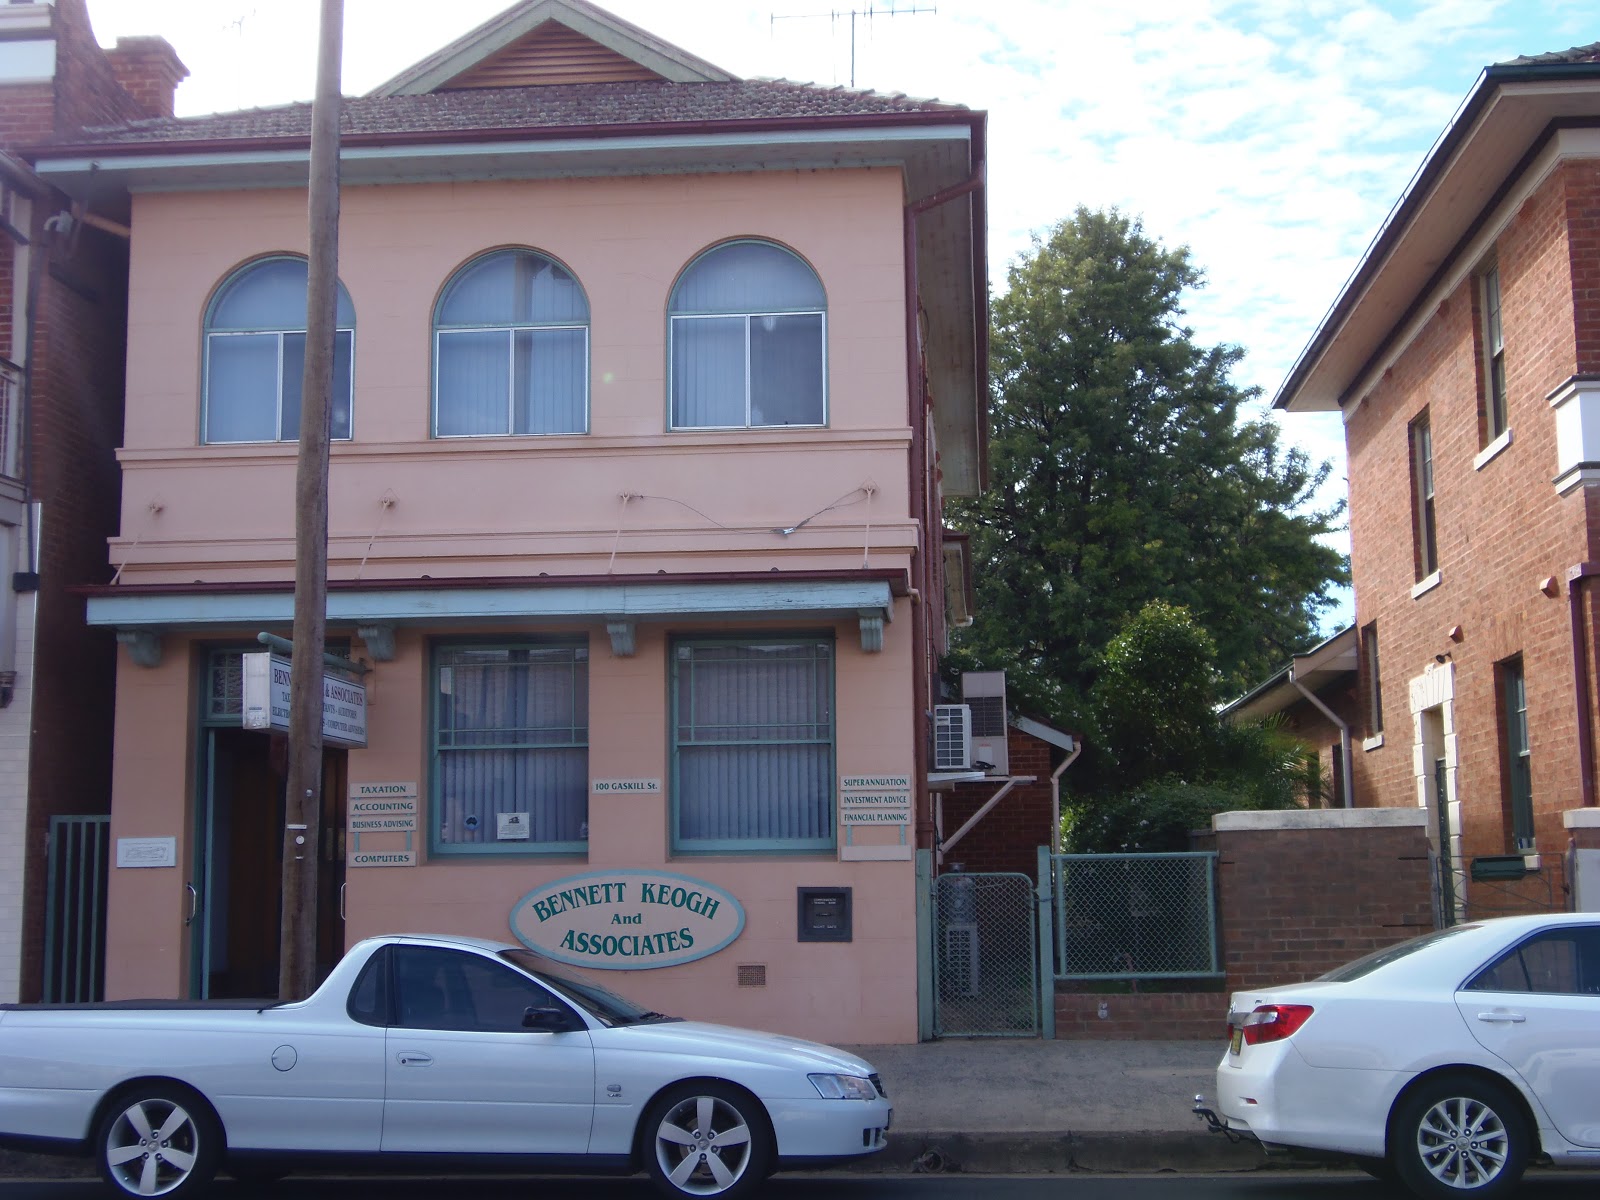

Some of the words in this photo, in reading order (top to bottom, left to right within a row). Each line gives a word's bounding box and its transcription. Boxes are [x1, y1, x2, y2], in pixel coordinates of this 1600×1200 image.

[330, 685, 364, 707] ASSOCIATES
[595, 782, 610, 791] 100
[611, 782, 645, 791] GASKILL
[647, 782, 658, 790] St.
[843, 778, 907, 787] SUPERANNUATION
[360, 785, 407, 794] TAXATION
[843, 796, 883, 804] INVESTMENT
[883, 795, 907, 804] ADVICE
[353, 802, 413, 811] ACCOUNTING
[844, 813, 876, 822] FINANCIAL
[876, 813, 908, 821] PLANNING
[352, 820, 382, 829] BUSINESS
[382, 819, 414, 828] ADVISING
[354, 854, 410, 863] COMPUTERS
[531, 882, 627, 923] BENNETT
[640, 882, 721, 920] KEOGH
[610, 912, 642, 925] And
[559, 927, 694, 957] ASSOCIATES
